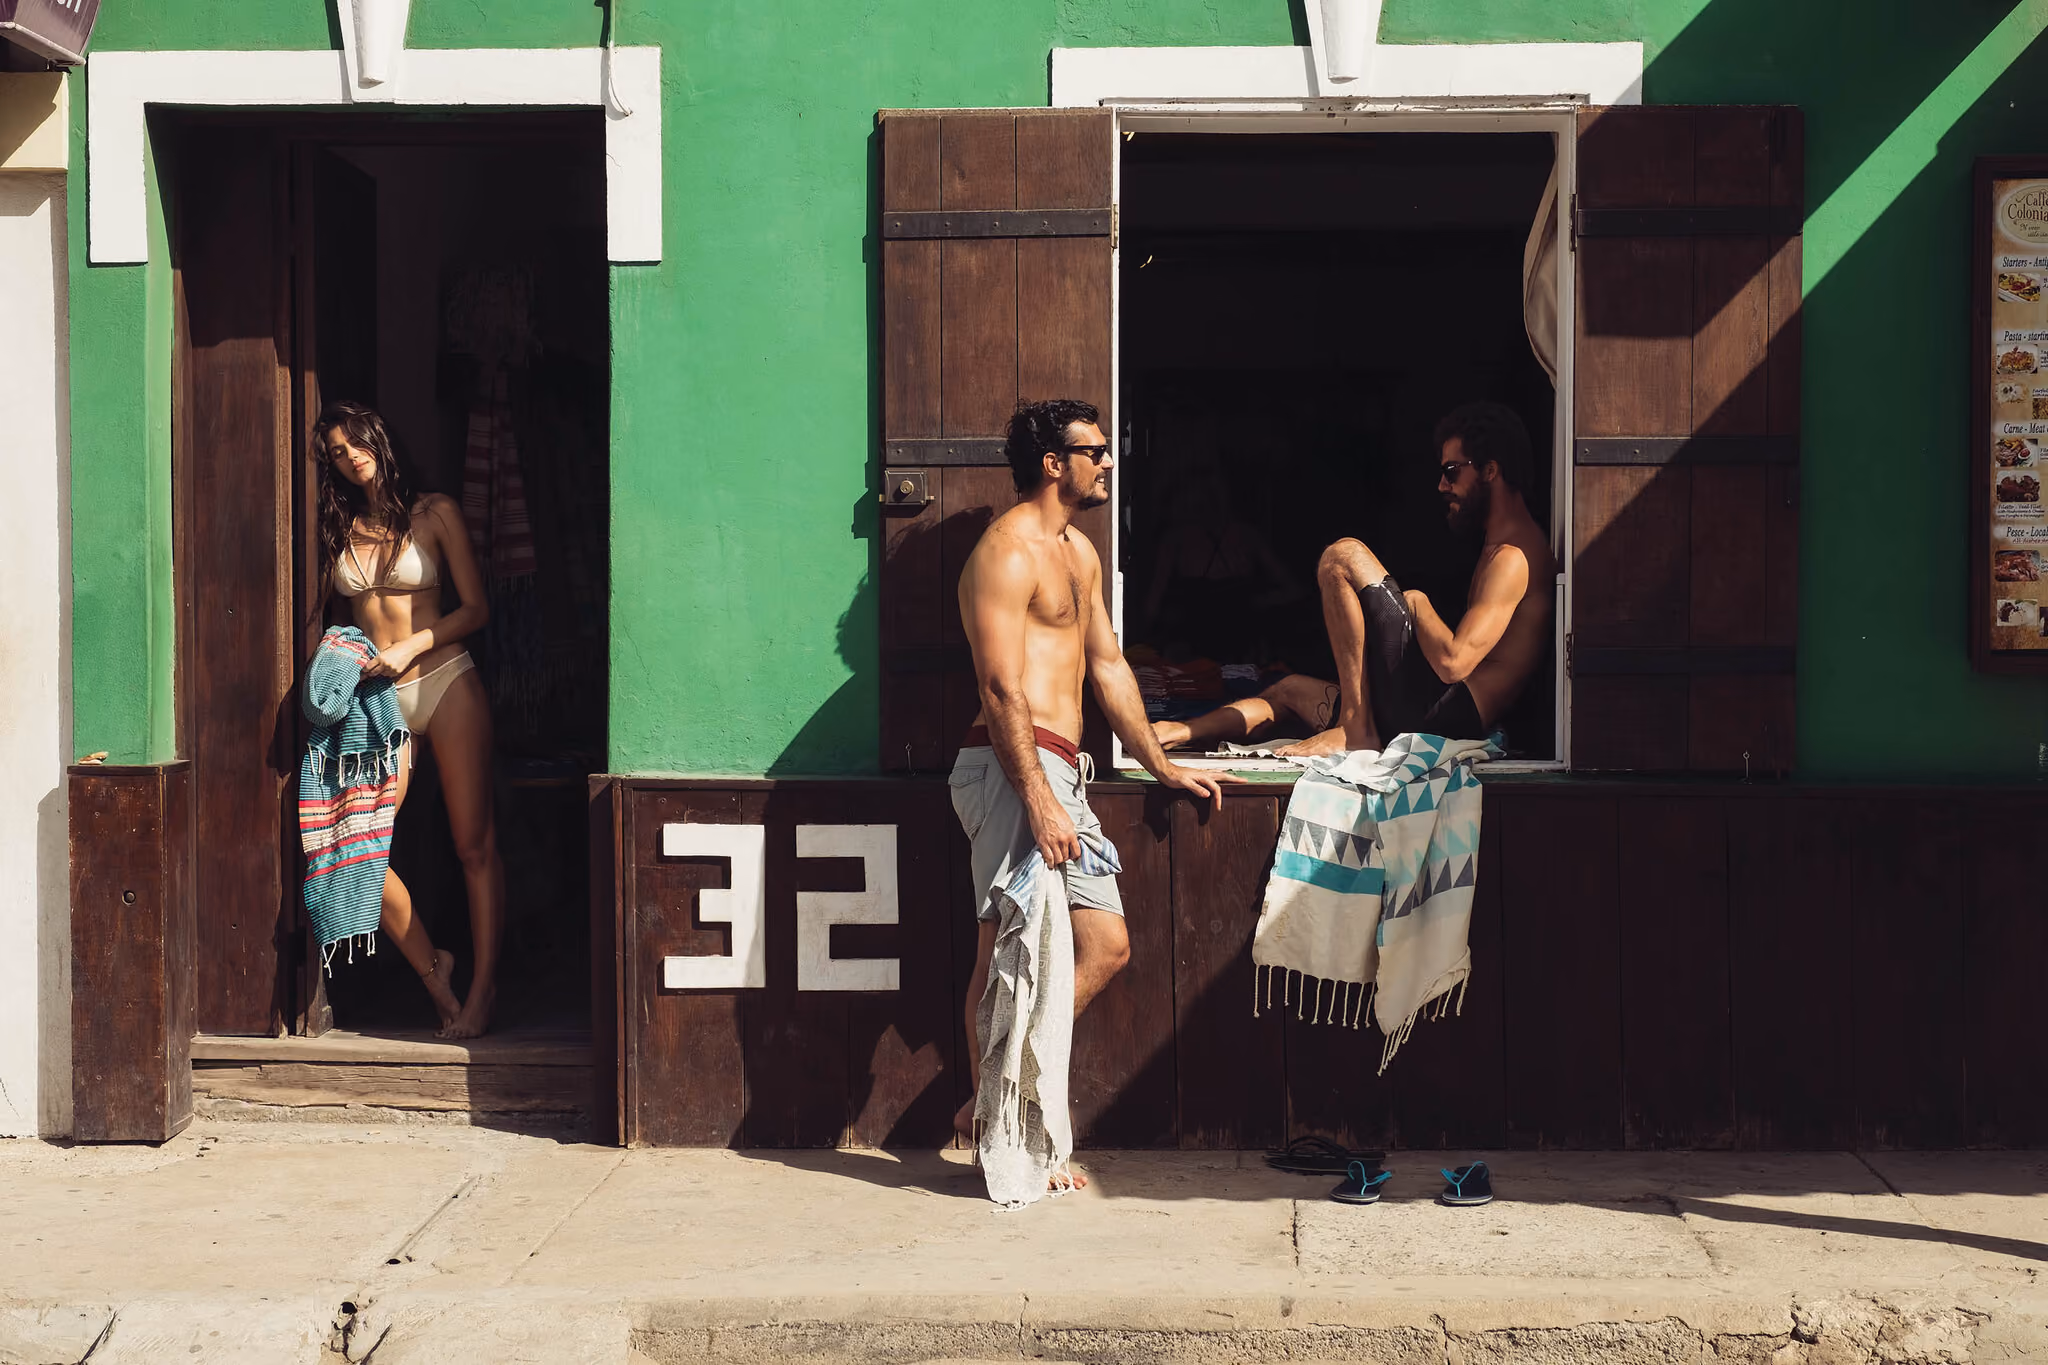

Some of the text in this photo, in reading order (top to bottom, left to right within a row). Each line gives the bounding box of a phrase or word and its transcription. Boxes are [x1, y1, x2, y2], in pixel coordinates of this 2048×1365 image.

[2002, 256, 2028, 268] Starters
[2004, 330, 2022, 342] Pasta
[2004, 422, 2023, 434] Carne
[2029, 422, 2045, 434] Meat
[2006, 526, 2024, 537] Pesce
[663, 824, 899, 991] 32
